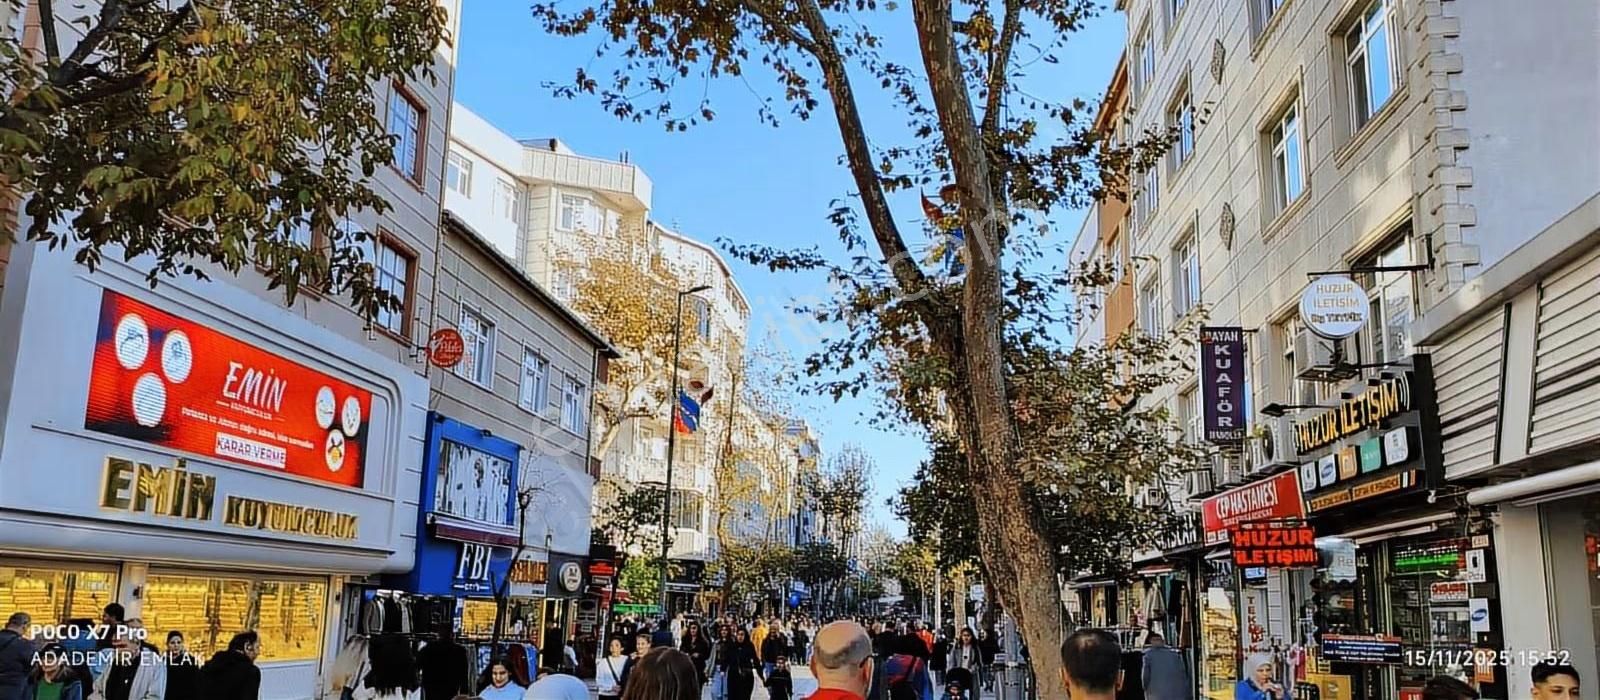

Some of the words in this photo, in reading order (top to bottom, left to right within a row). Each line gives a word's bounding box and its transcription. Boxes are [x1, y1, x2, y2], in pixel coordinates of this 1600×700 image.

[1315, 283, 1353, 294] HUZUR
[223, 361, 287, 412] EMİN
[1214, 345, 1233, 427] KUAFÖR
[218, 437, 251, 456] KARAR
[253, 446, 285, 464] VERME
[1298, 408, 1339, 453] HUZUR
[100, 456, 217, 521] EMİN
[1235, 530, 1313, 547] HUZUR
[456, 542, 493, 581] FBI
